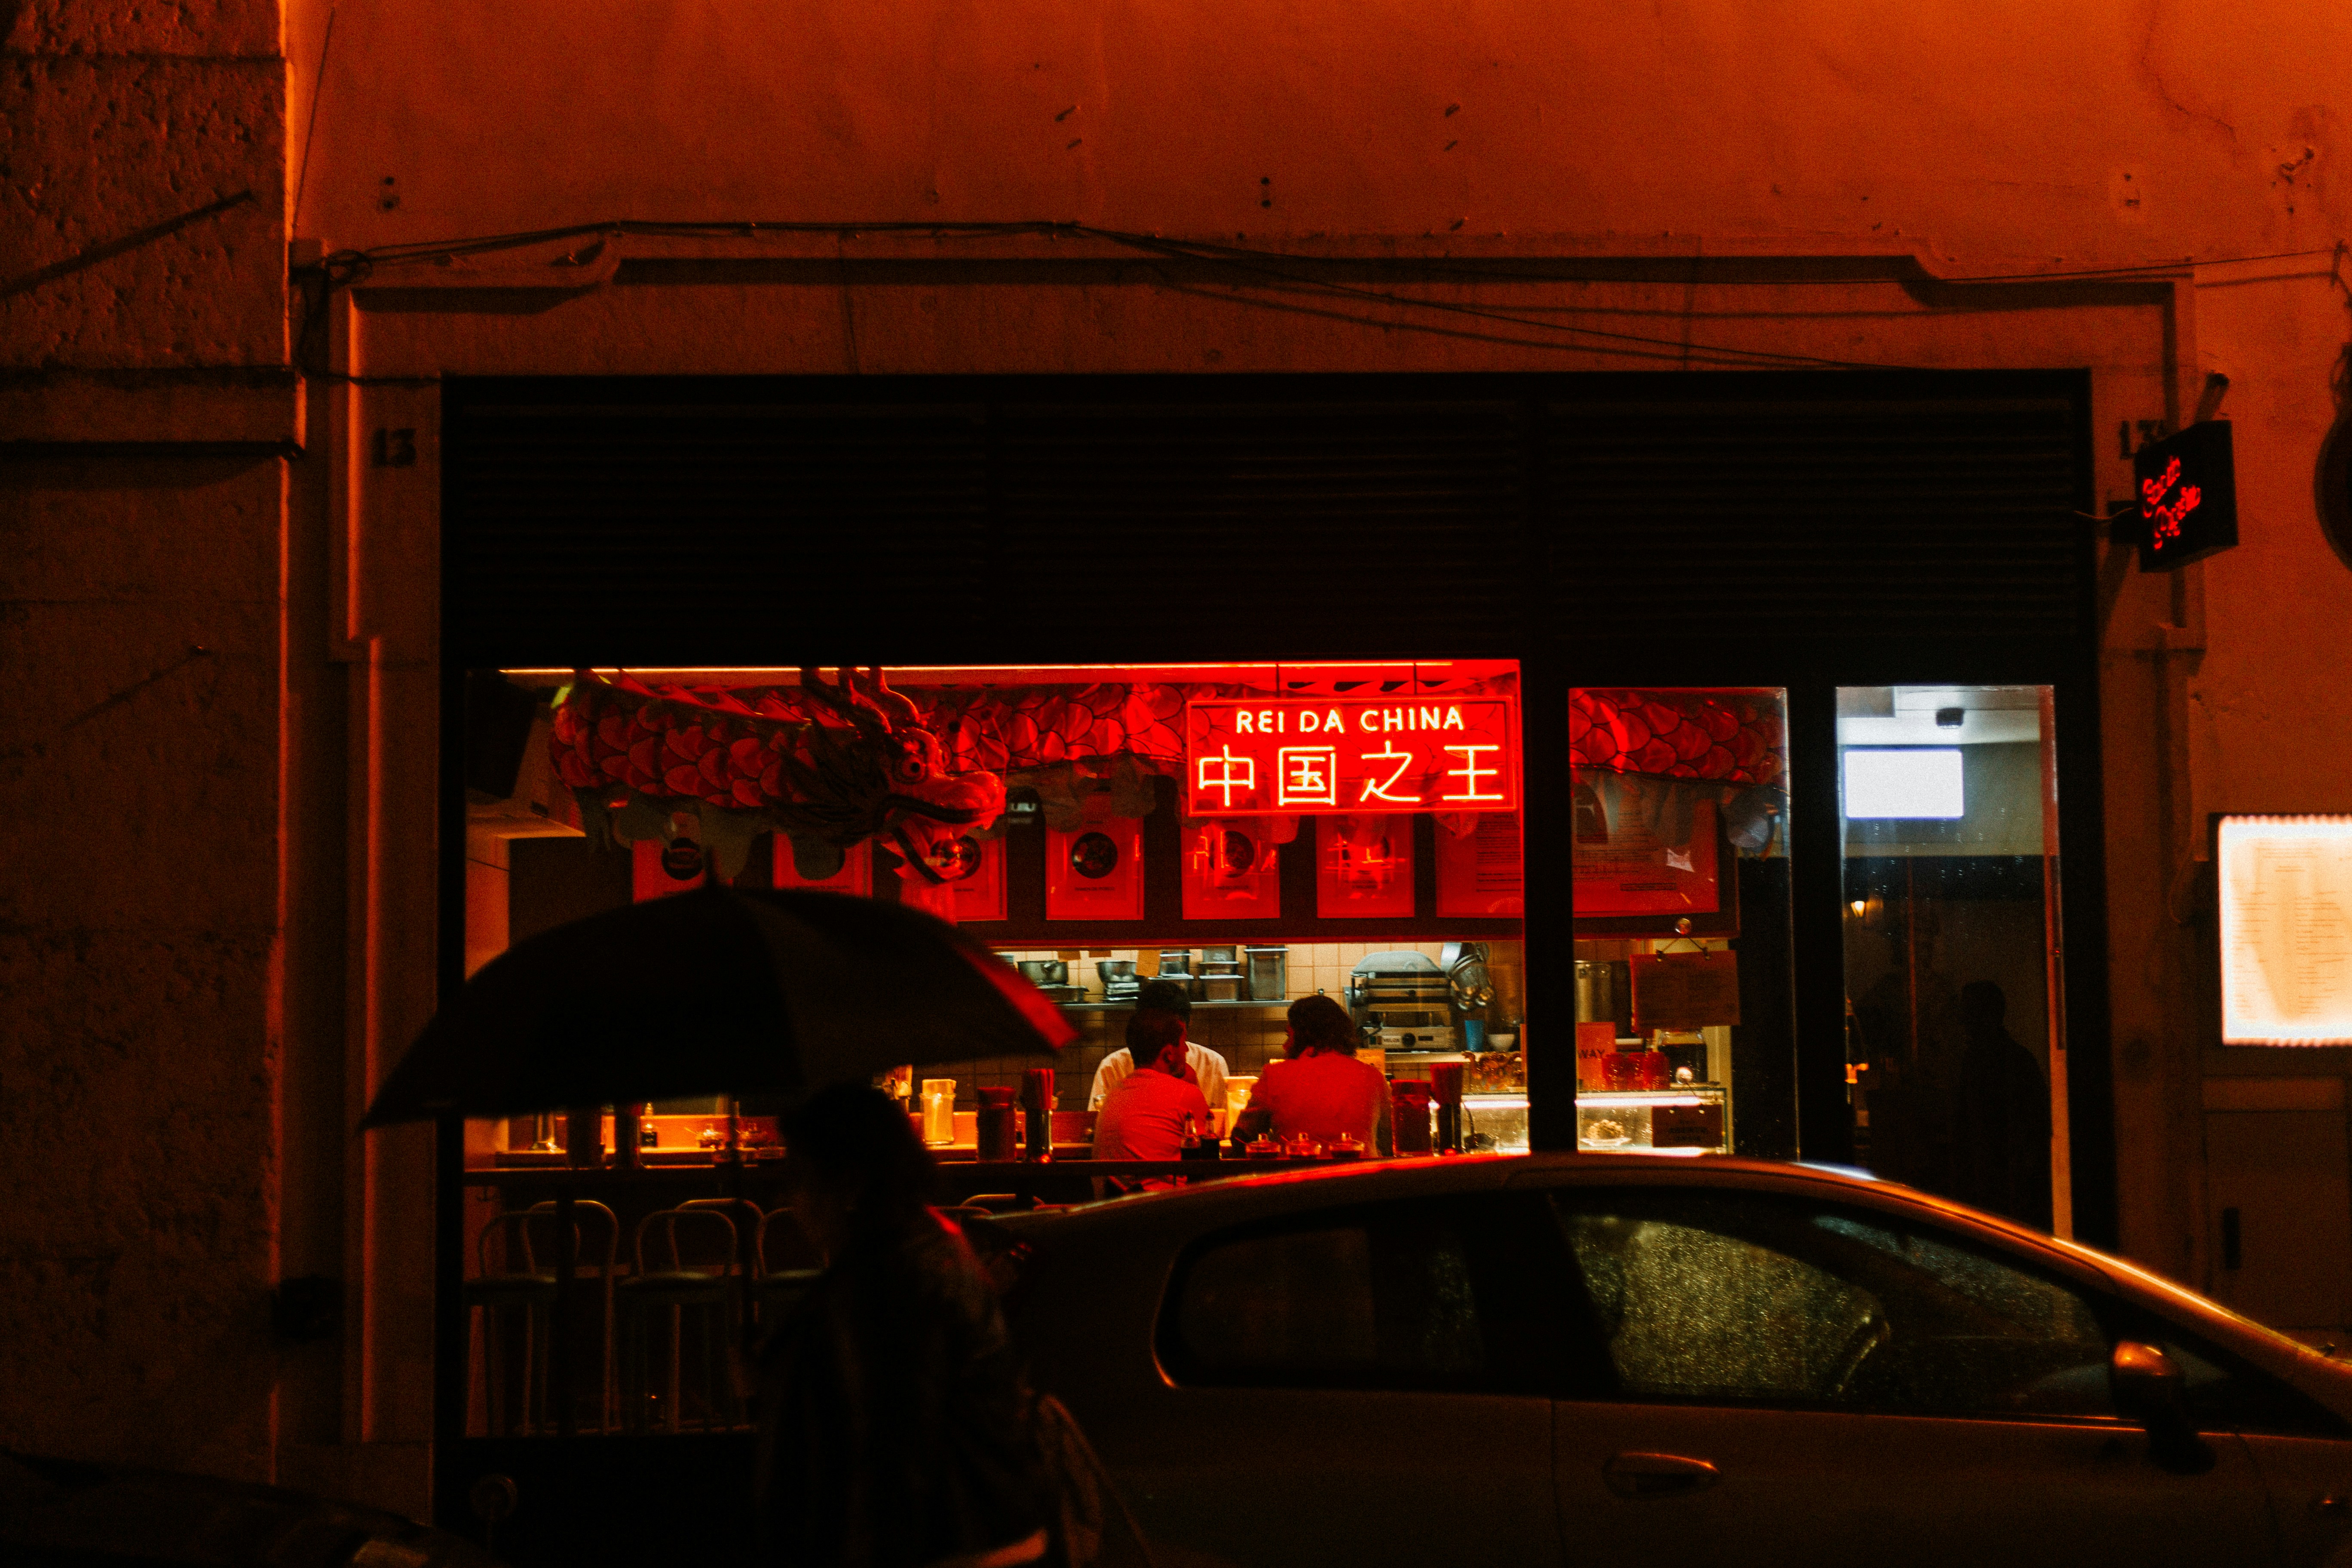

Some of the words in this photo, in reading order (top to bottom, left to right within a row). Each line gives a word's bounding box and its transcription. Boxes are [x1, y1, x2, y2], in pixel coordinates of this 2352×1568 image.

[1236, 710, 1284, 733] REI
[1299, 710, 1344, 733] DA
[1360, 706, 1464, 732] CHINA
[1198, 740, 1504, 806] 中国之王
